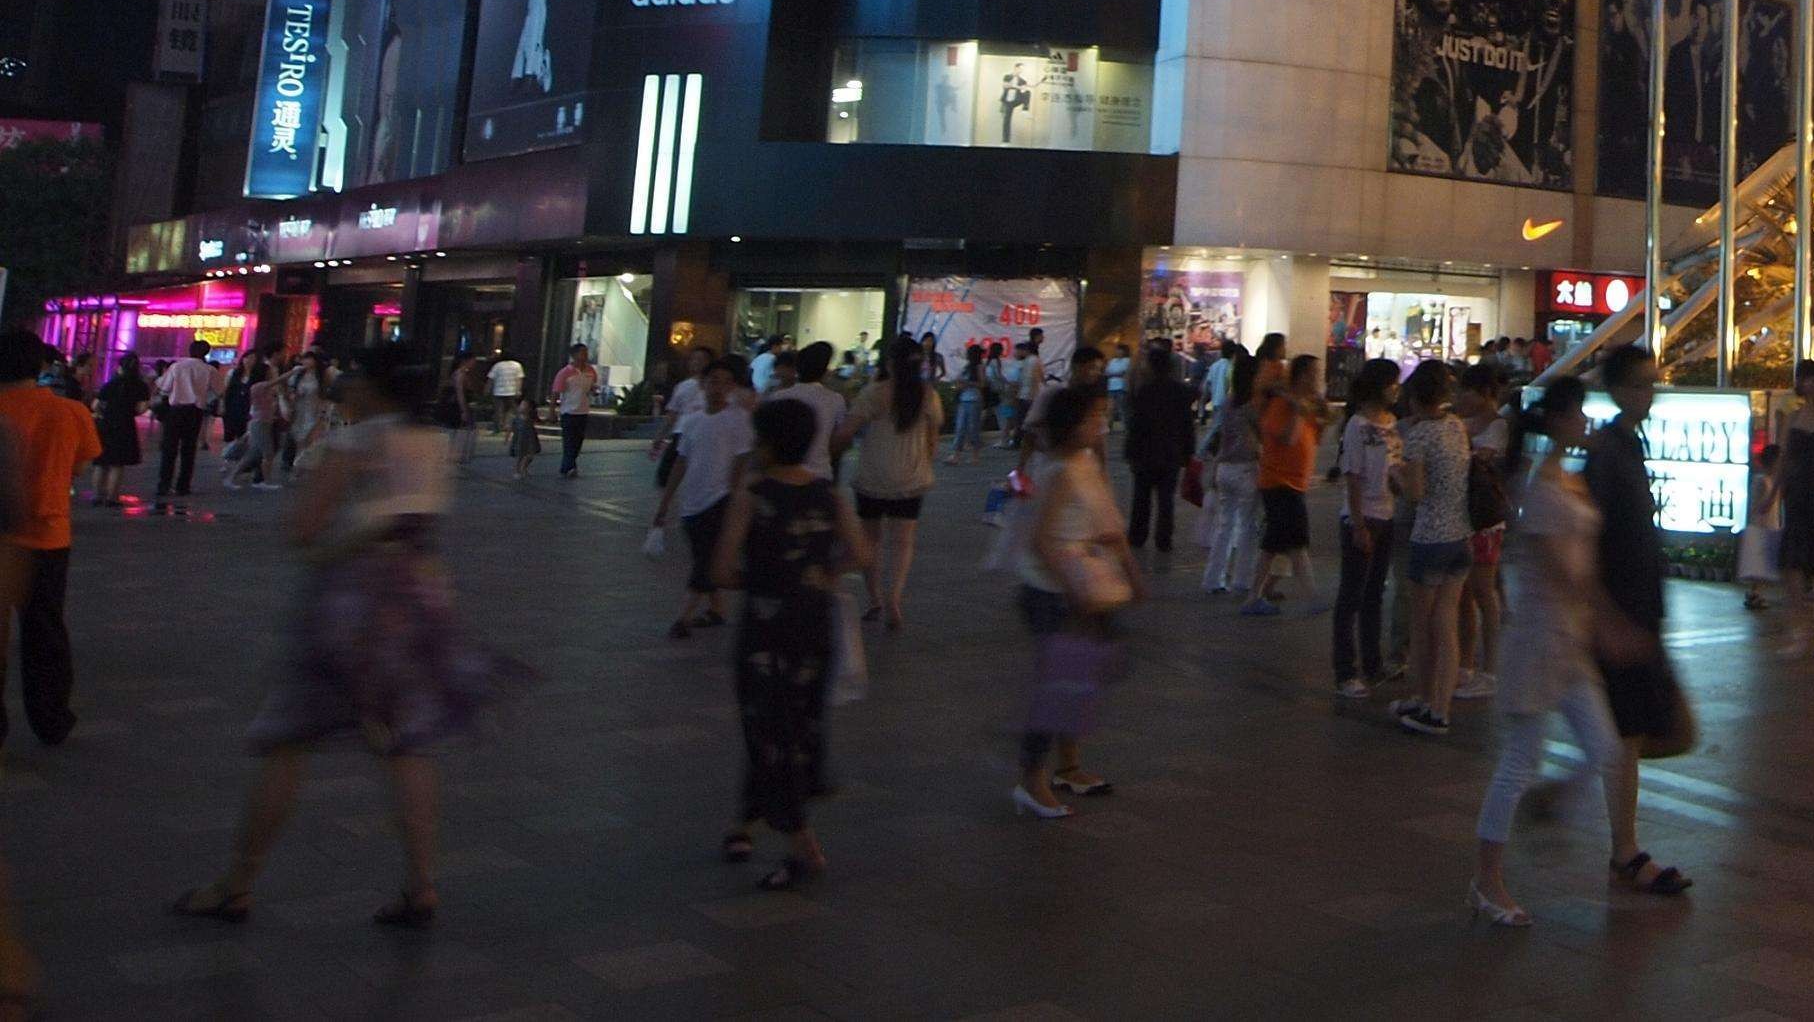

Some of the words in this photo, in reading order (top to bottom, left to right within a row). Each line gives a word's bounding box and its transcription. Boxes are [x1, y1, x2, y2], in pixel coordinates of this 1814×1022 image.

[1435, 34, 1488, 64] JUST
[1484, 44, 1508, 70] DO
[1509, 50, 1529, 72] IT
[269, 100, 302, 153] 通灵
